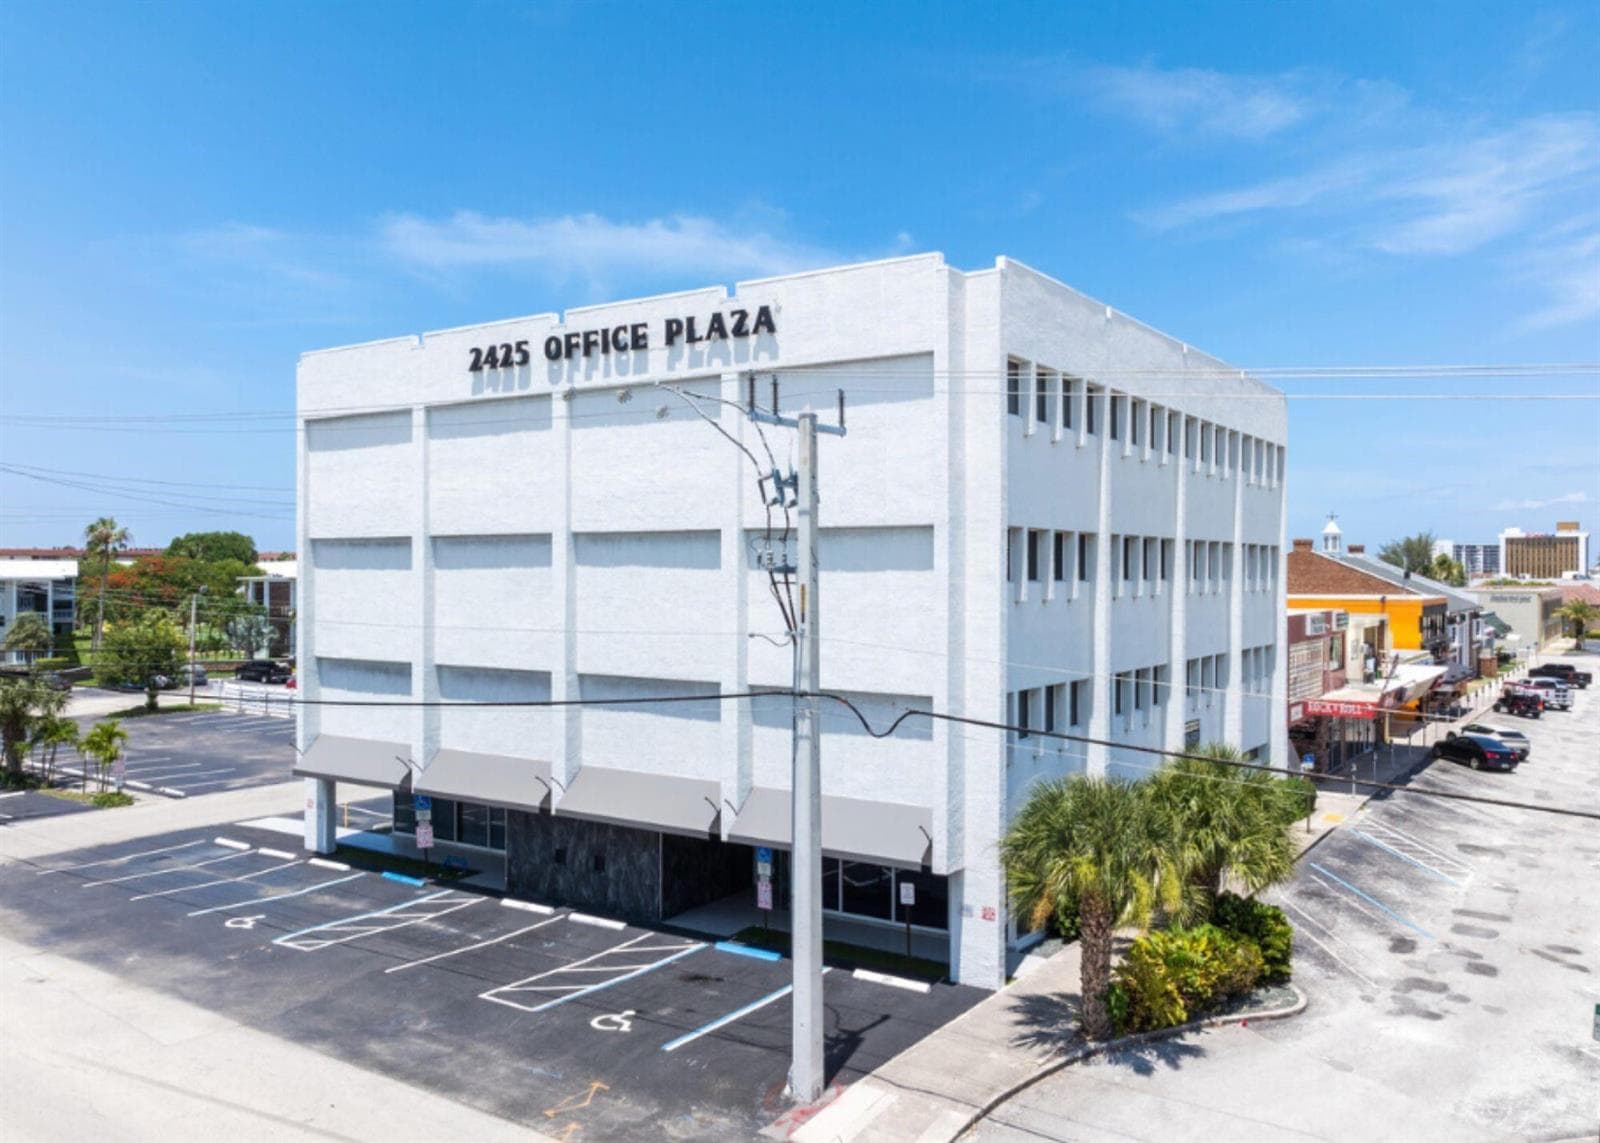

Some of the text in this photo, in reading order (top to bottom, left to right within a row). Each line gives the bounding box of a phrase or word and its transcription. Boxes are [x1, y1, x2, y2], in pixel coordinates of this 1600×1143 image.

[468, 305, 776, 372] 2425 OFFICE PLAZA
